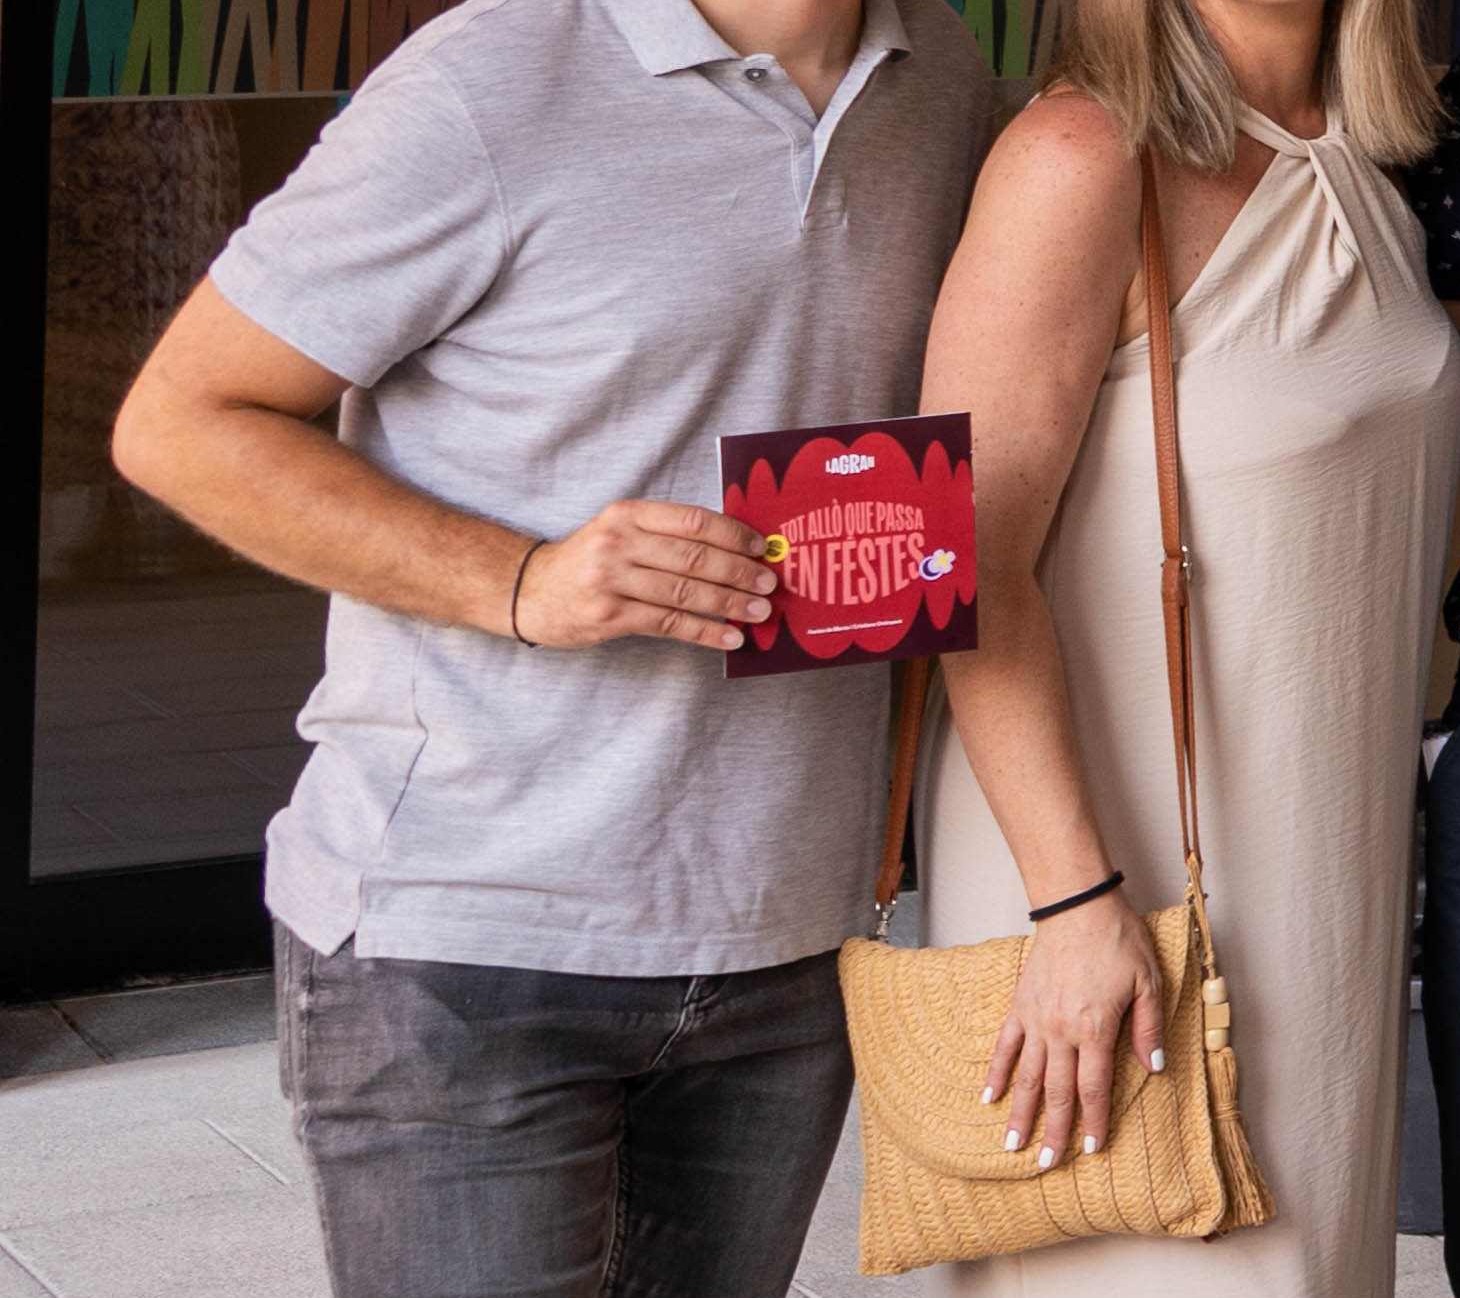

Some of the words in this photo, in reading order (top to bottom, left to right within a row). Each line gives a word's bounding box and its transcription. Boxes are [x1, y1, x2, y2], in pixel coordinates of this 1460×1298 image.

[780, 514, 806, 544] TOT
[808, 498, 842, 540] ALLÒ
[845, 501, 875, 540] QUE
[876, 501, 925, 533] PASSA
[784, 543, 819, 602] EN
